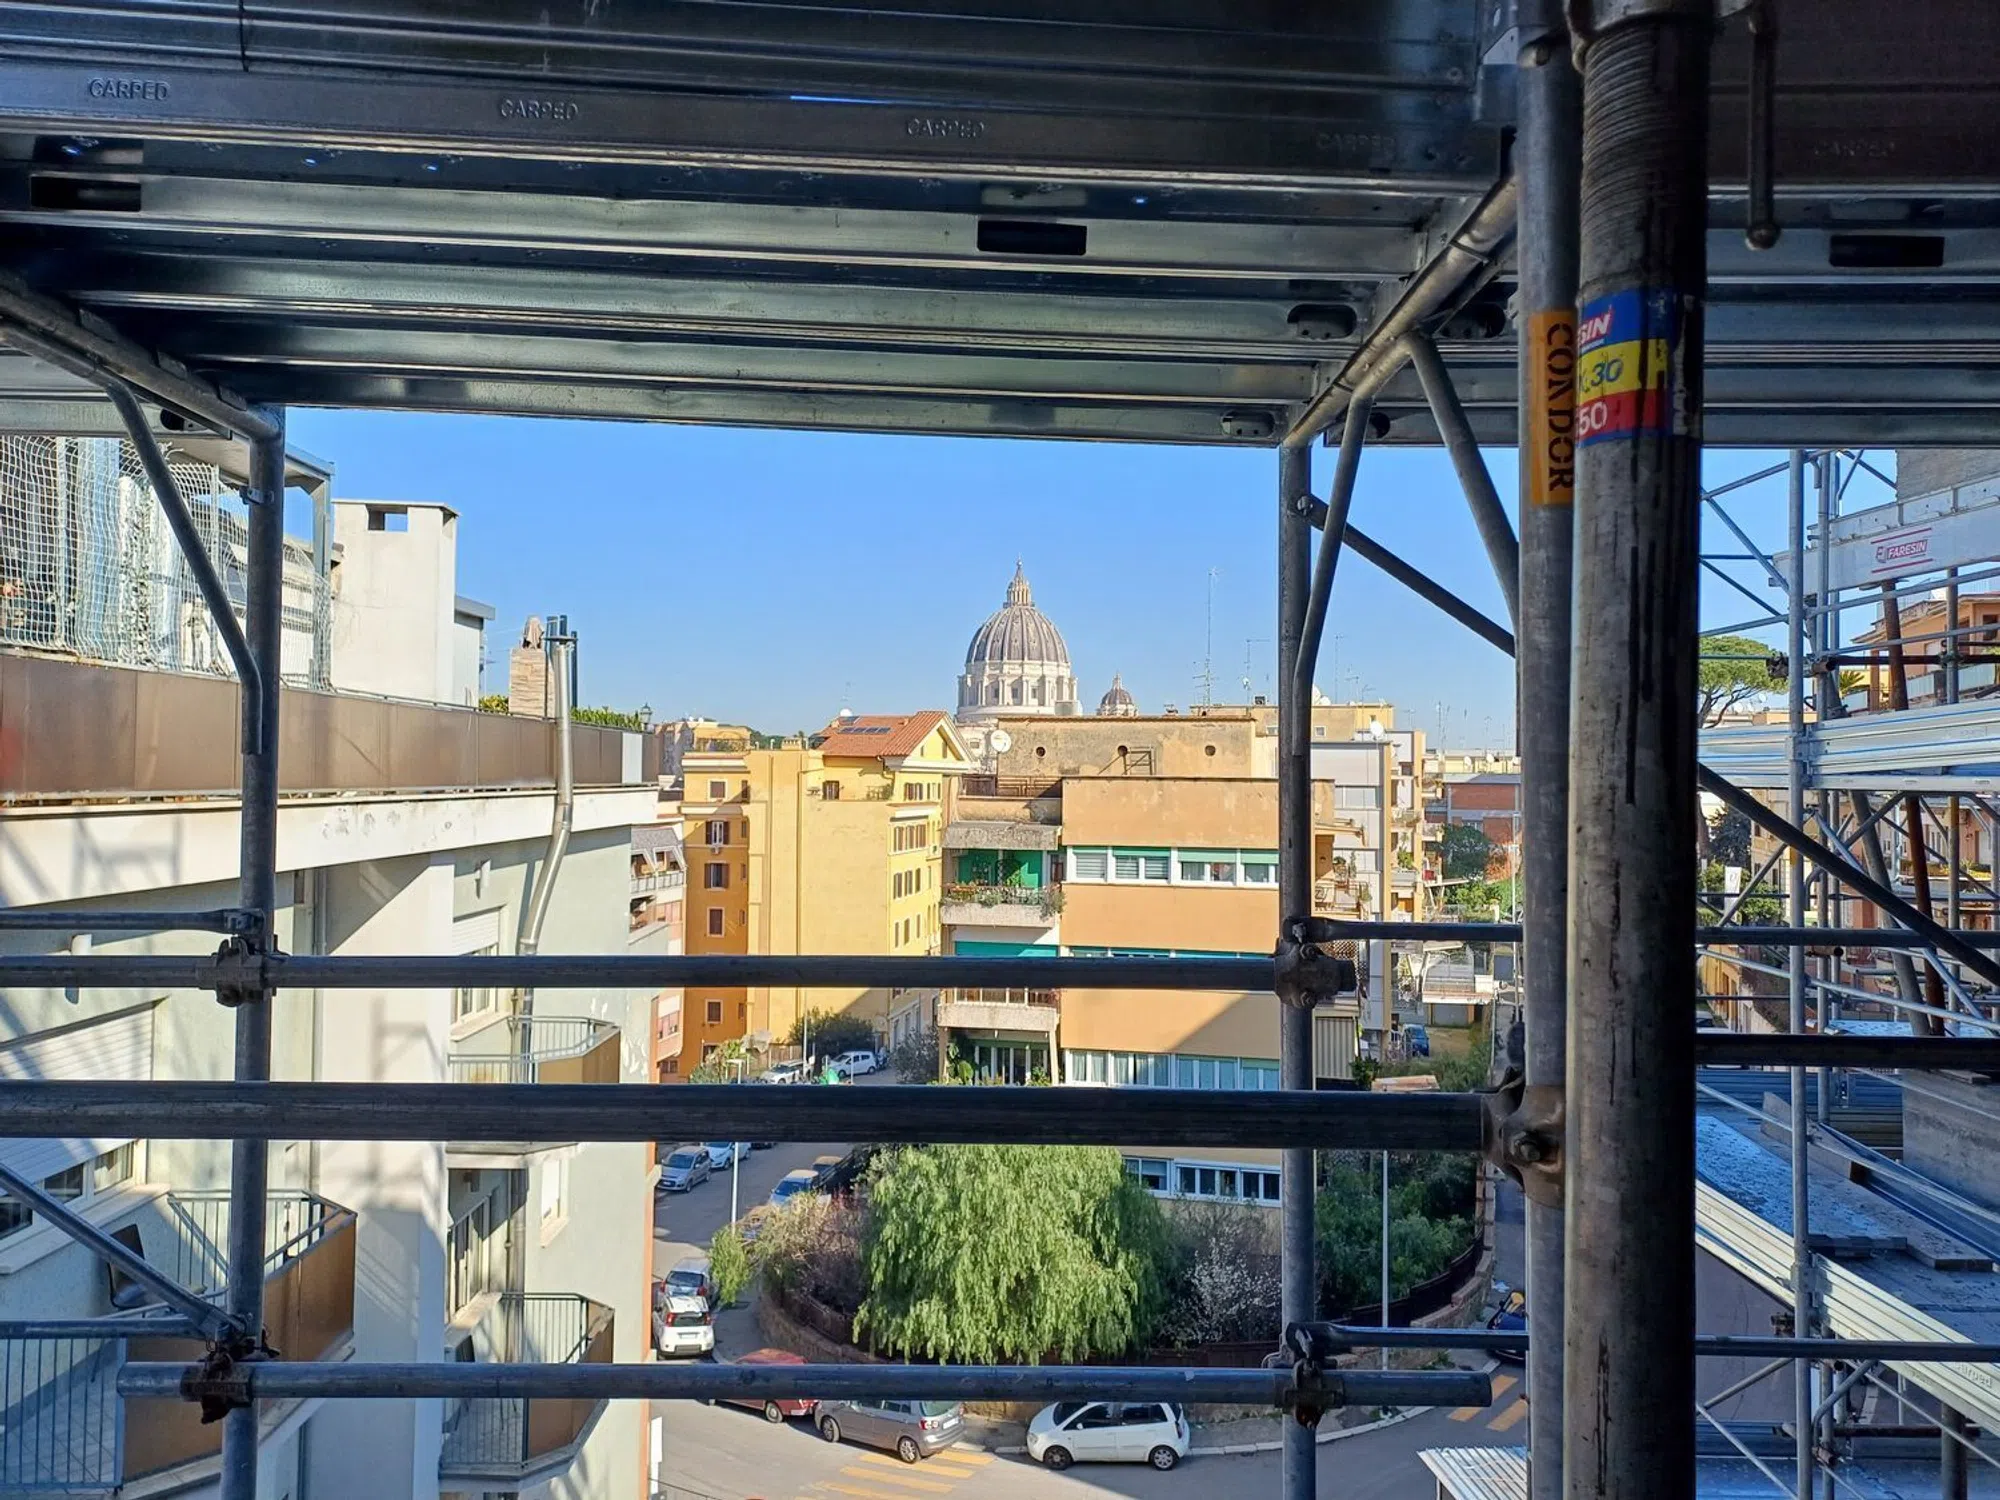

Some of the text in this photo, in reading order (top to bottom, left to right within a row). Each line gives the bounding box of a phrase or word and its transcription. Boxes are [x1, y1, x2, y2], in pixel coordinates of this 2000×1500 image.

[89, 77, 171, 101] CARPED
[499, 97, 580, 121] CARPED
[906, 117, 987, 139] CARPED
[1578, 312, 1612, 345] SIN
[1547, 323, 1574, 492] CONDOR
[1576, 402, 1608, 436] 50
[1888, 540, 1926, 560] FARESIN
